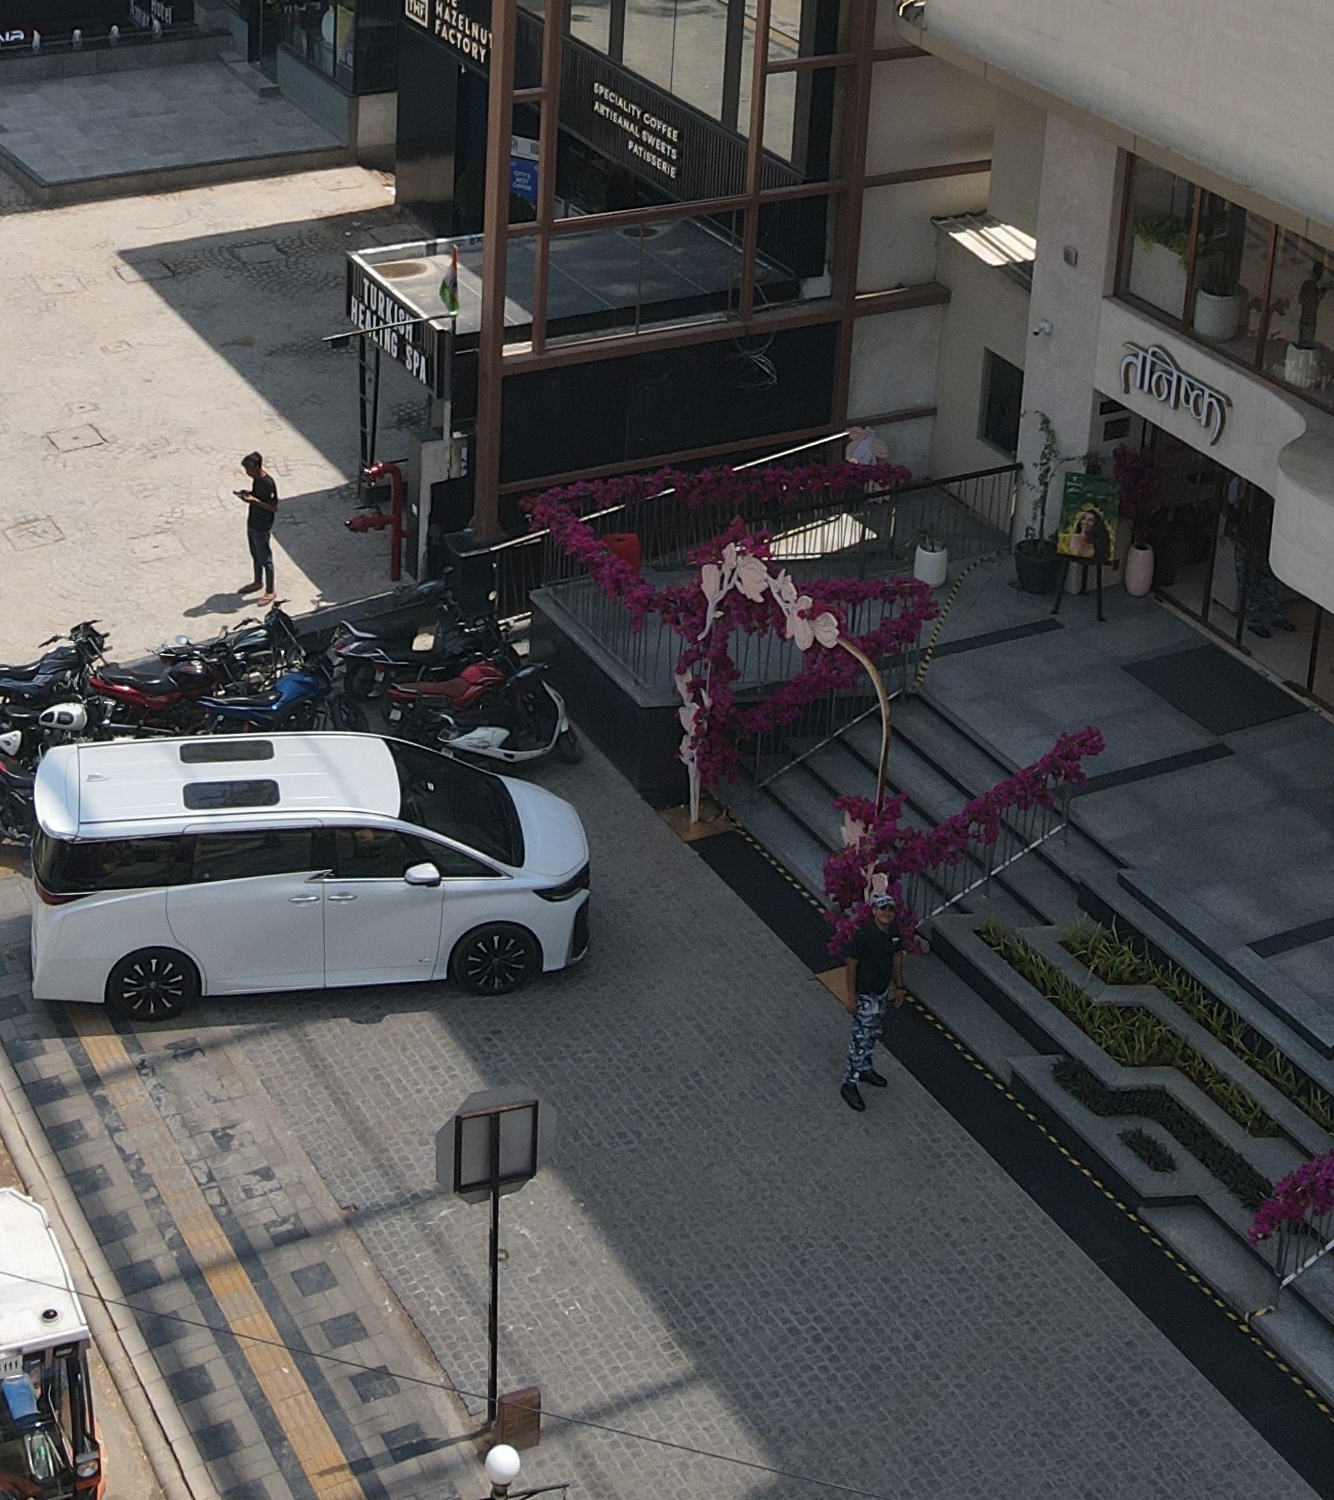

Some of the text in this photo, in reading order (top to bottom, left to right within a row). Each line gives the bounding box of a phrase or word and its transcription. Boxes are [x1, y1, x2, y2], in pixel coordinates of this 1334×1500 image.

[435, 19, 487, 63] FACTORY
[593, 101, 677, 160] ARTISANAL SWEETS
[594, 82, 679, 142] SPECIALITY COFFEE
[628, 140, 676, 179] PATISSERIE
[351, 295, 426, 384] HEALING SPA
[363, 278, 413, 343] TURKISH
